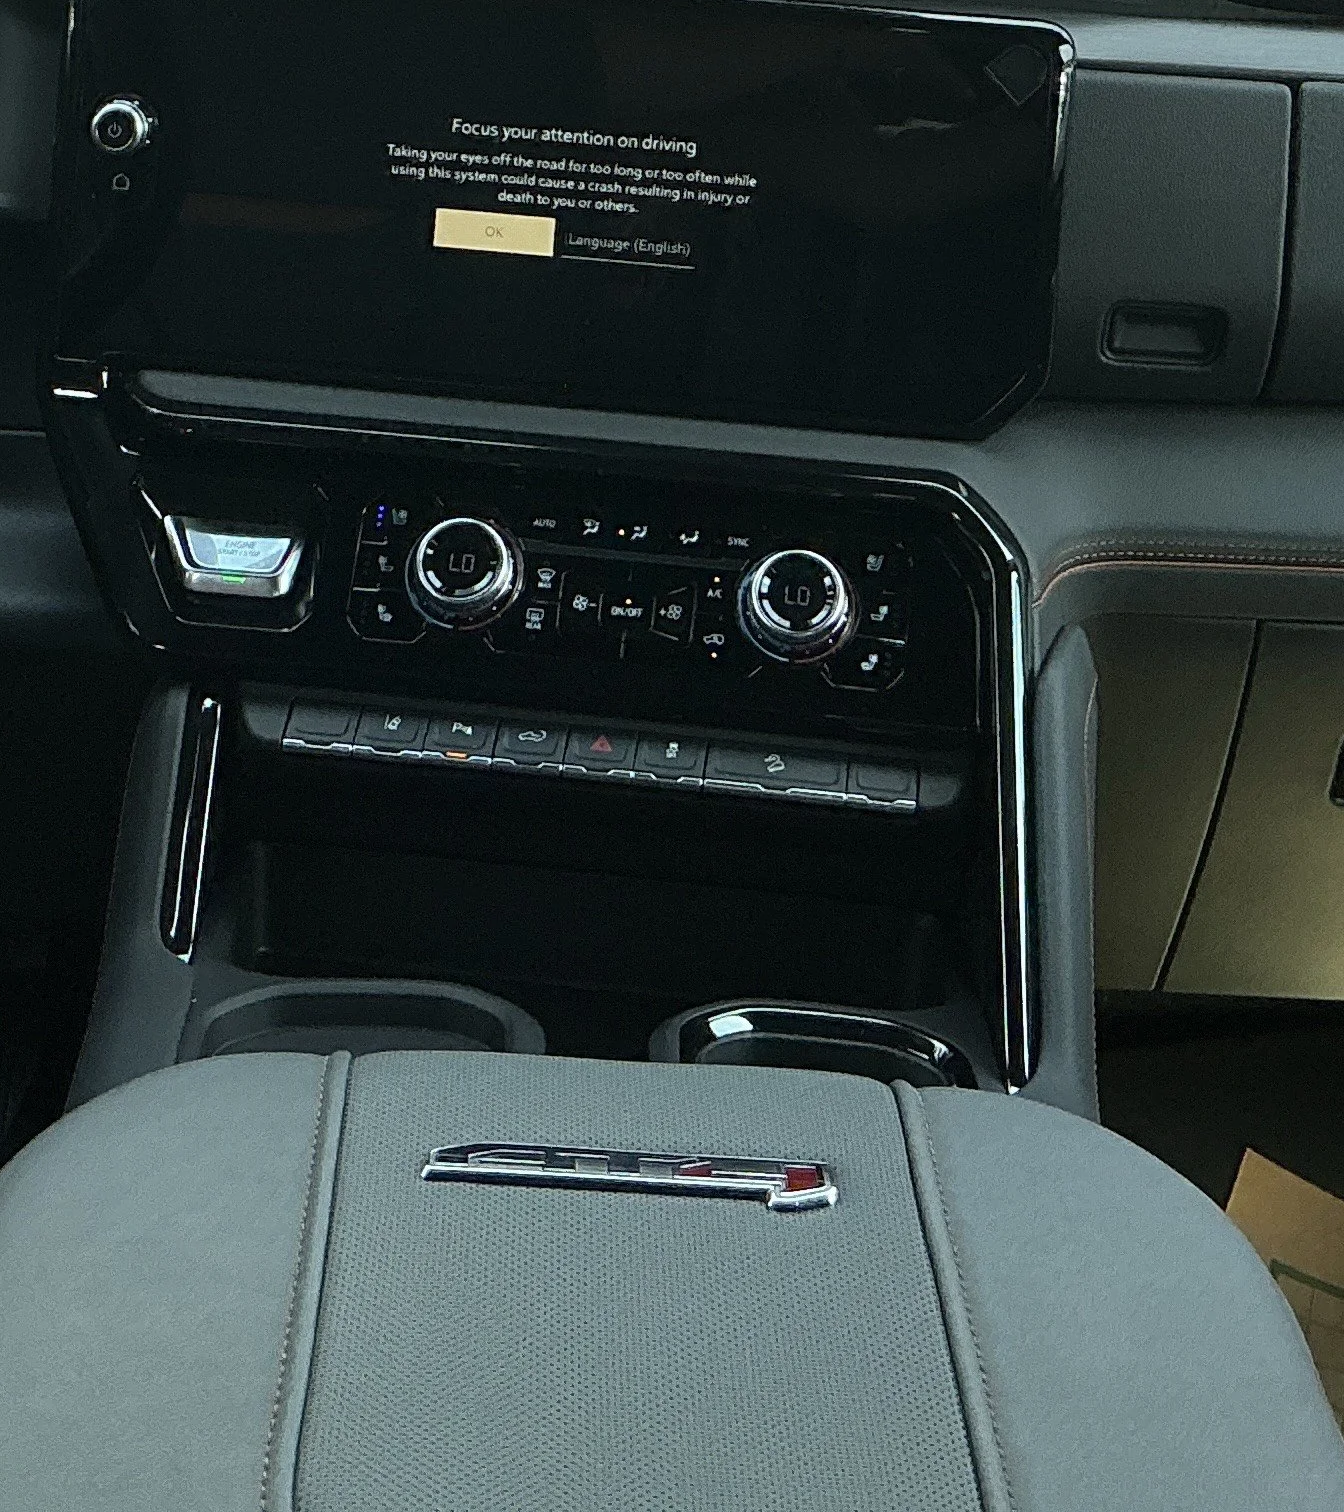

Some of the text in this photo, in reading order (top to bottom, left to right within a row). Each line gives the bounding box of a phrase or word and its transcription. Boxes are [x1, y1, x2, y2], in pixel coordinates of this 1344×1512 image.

[451, 118, 697, 158] Focus your attention on driving
[387, 143, 757, 187] Taking your eyes off the road for too long or too often while
[391, 163, 750, 206] using this system could cause a crash resulting in injury or
[497, 190, 639, 213] death to you or others.
[485, 226, 504, 238] OK
[567, 233, 691, 257] Language (English)
[707, 588, 722, 599] A/C
